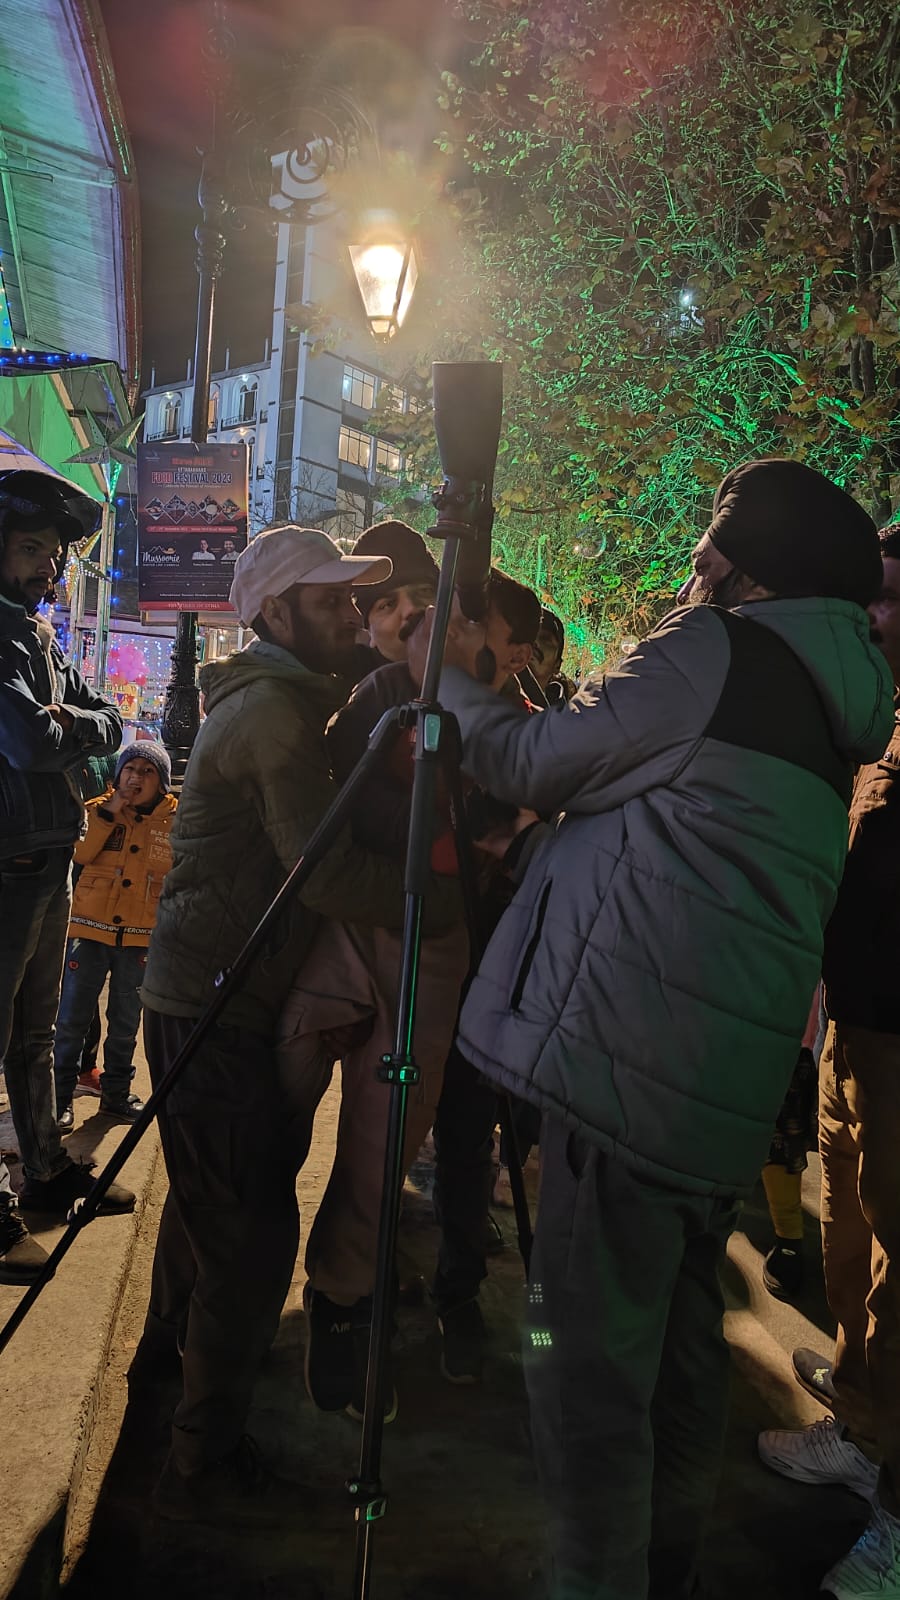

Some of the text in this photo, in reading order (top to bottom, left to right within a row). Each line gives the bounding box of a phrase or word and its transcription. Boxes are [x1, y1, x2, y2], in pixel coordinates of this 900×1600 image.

[151, 472, 232, 484] FOOD FESTIVAL 2023
[141, 552, 180, 563] Mussoorie
